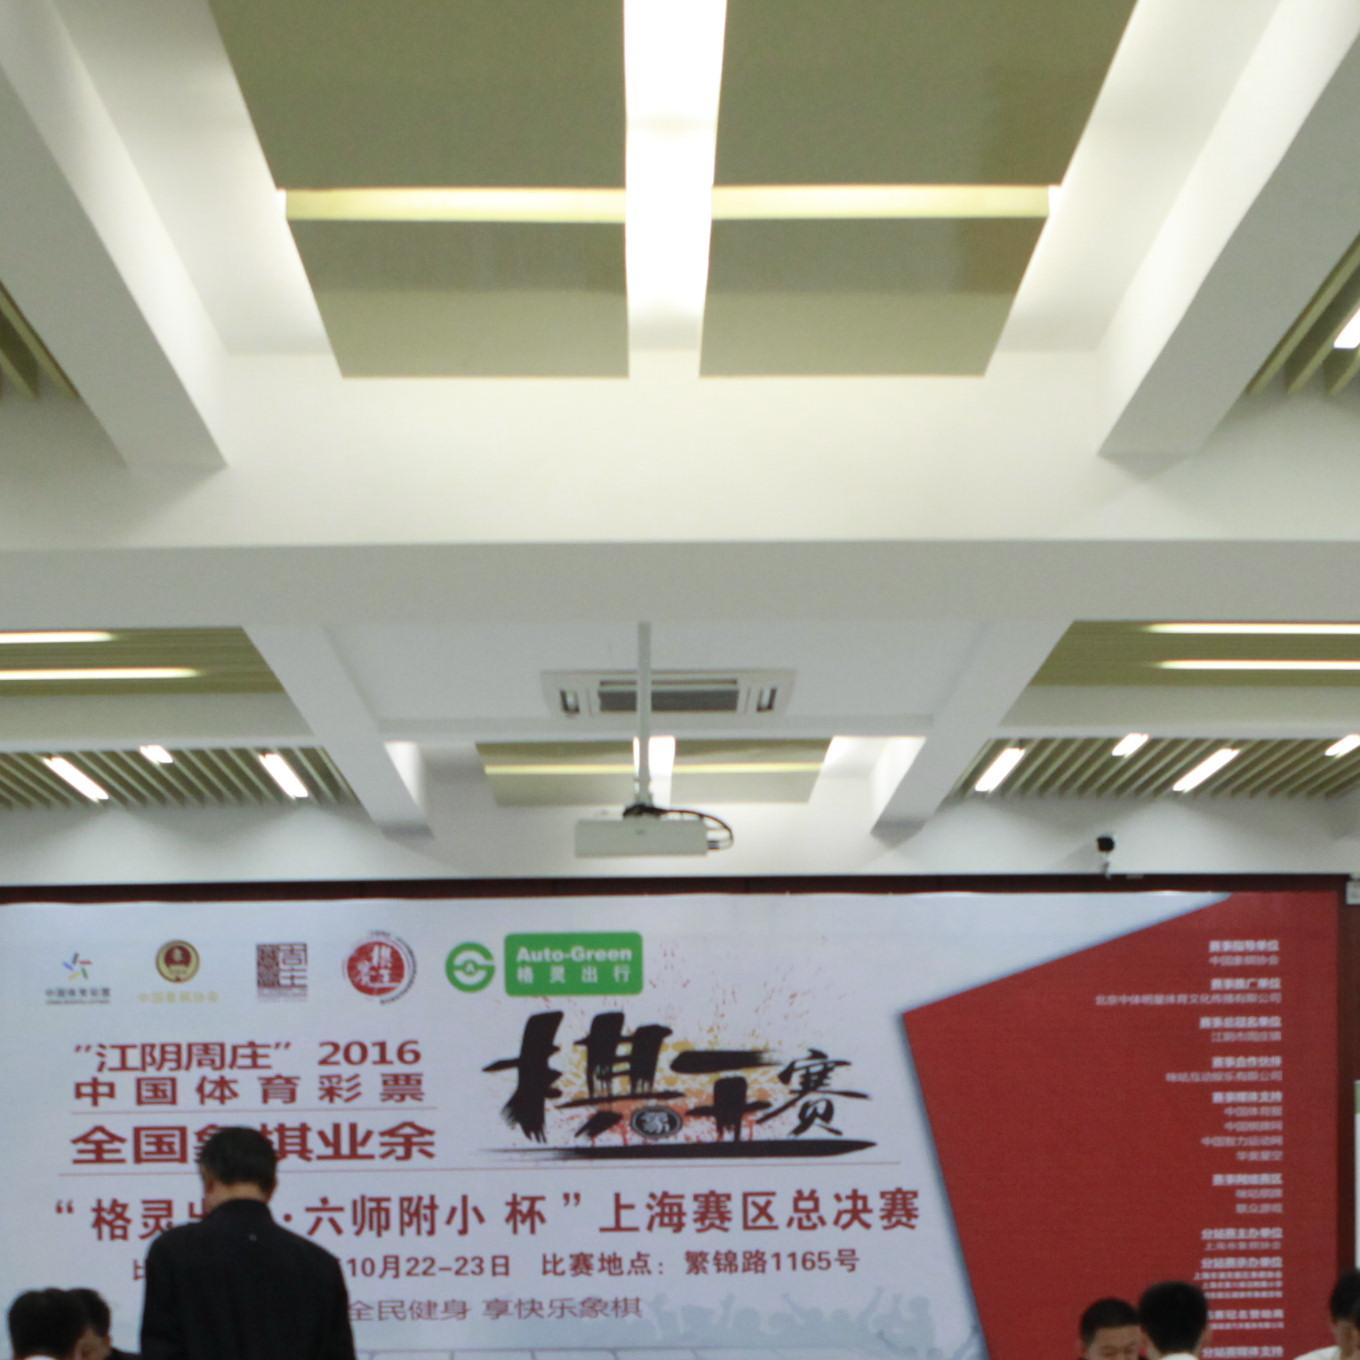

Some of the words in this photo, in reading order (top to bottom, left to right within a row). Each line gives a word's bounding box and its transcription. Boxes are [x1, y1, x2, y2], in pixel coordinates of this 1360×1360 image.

[516, 946, 632, 962] Auto-Green
[517, 964, 630, 983] 格灵出行
[317, 1040, 422, 1066] 2016
[74, 1073, 424, 1106] 中国体育彩票
[349, 1300, 471, 1321] 全民健身
[482, 1297, 643, 1320] 享快乐象棋
